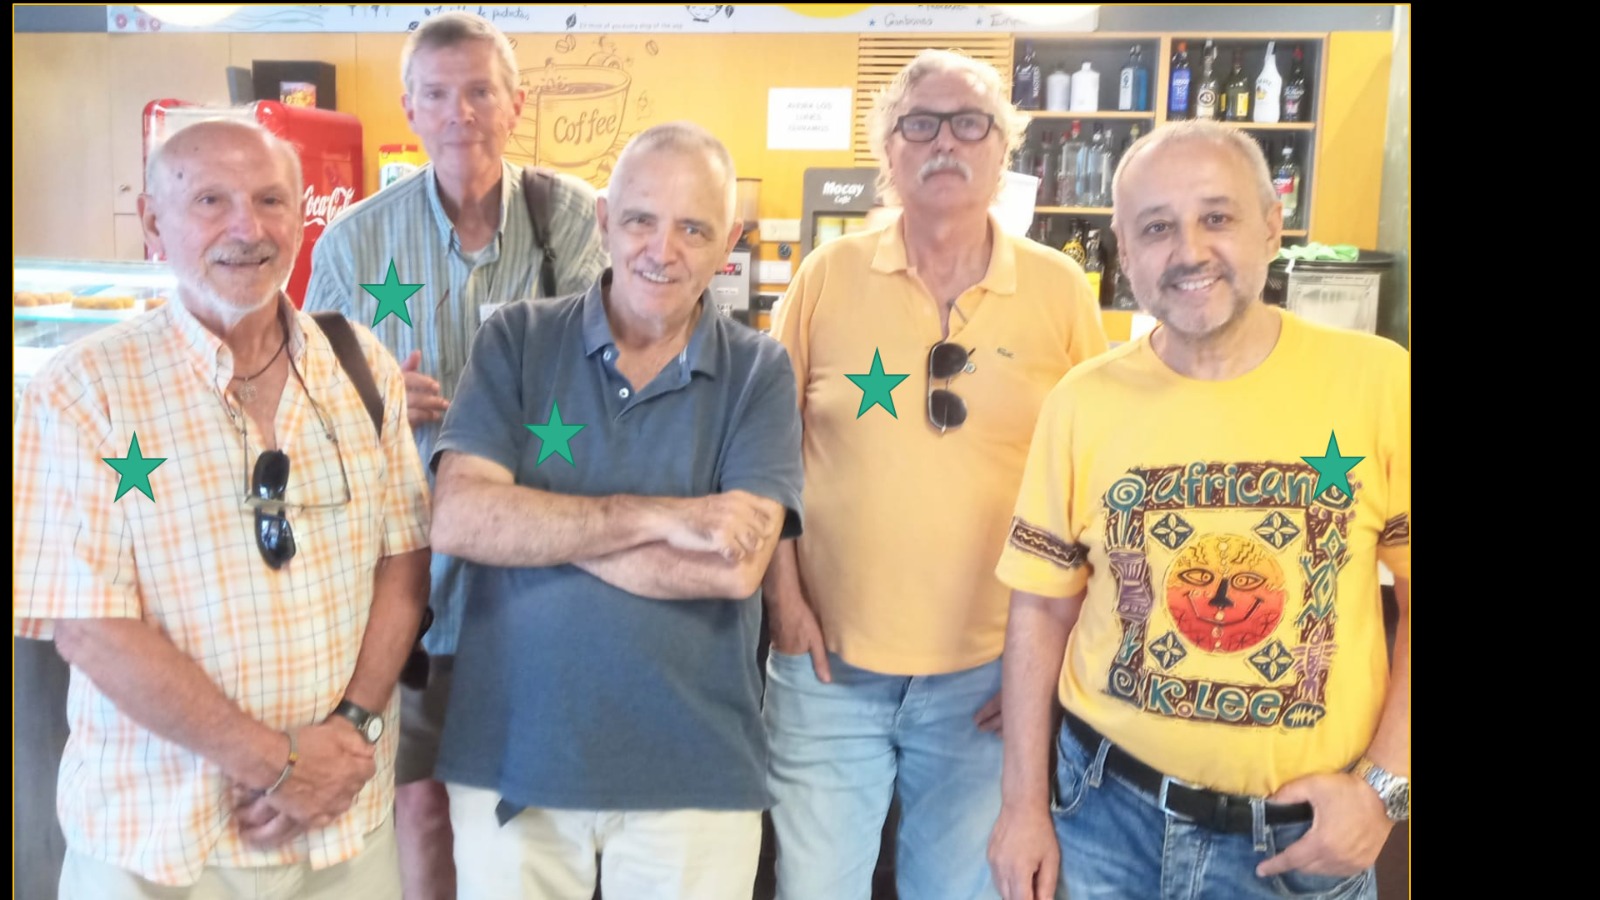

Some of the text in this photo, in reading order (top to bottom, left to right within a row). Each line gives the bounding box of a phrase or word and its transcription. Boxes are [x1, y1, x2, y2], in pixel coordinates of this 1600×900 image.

[553, 108, 617, 146] Coffee
[303, 184, 355, 225] oca-Cl
[822, 181, 865, 197] Mocay
[1152, 462, 1315, 506] african
